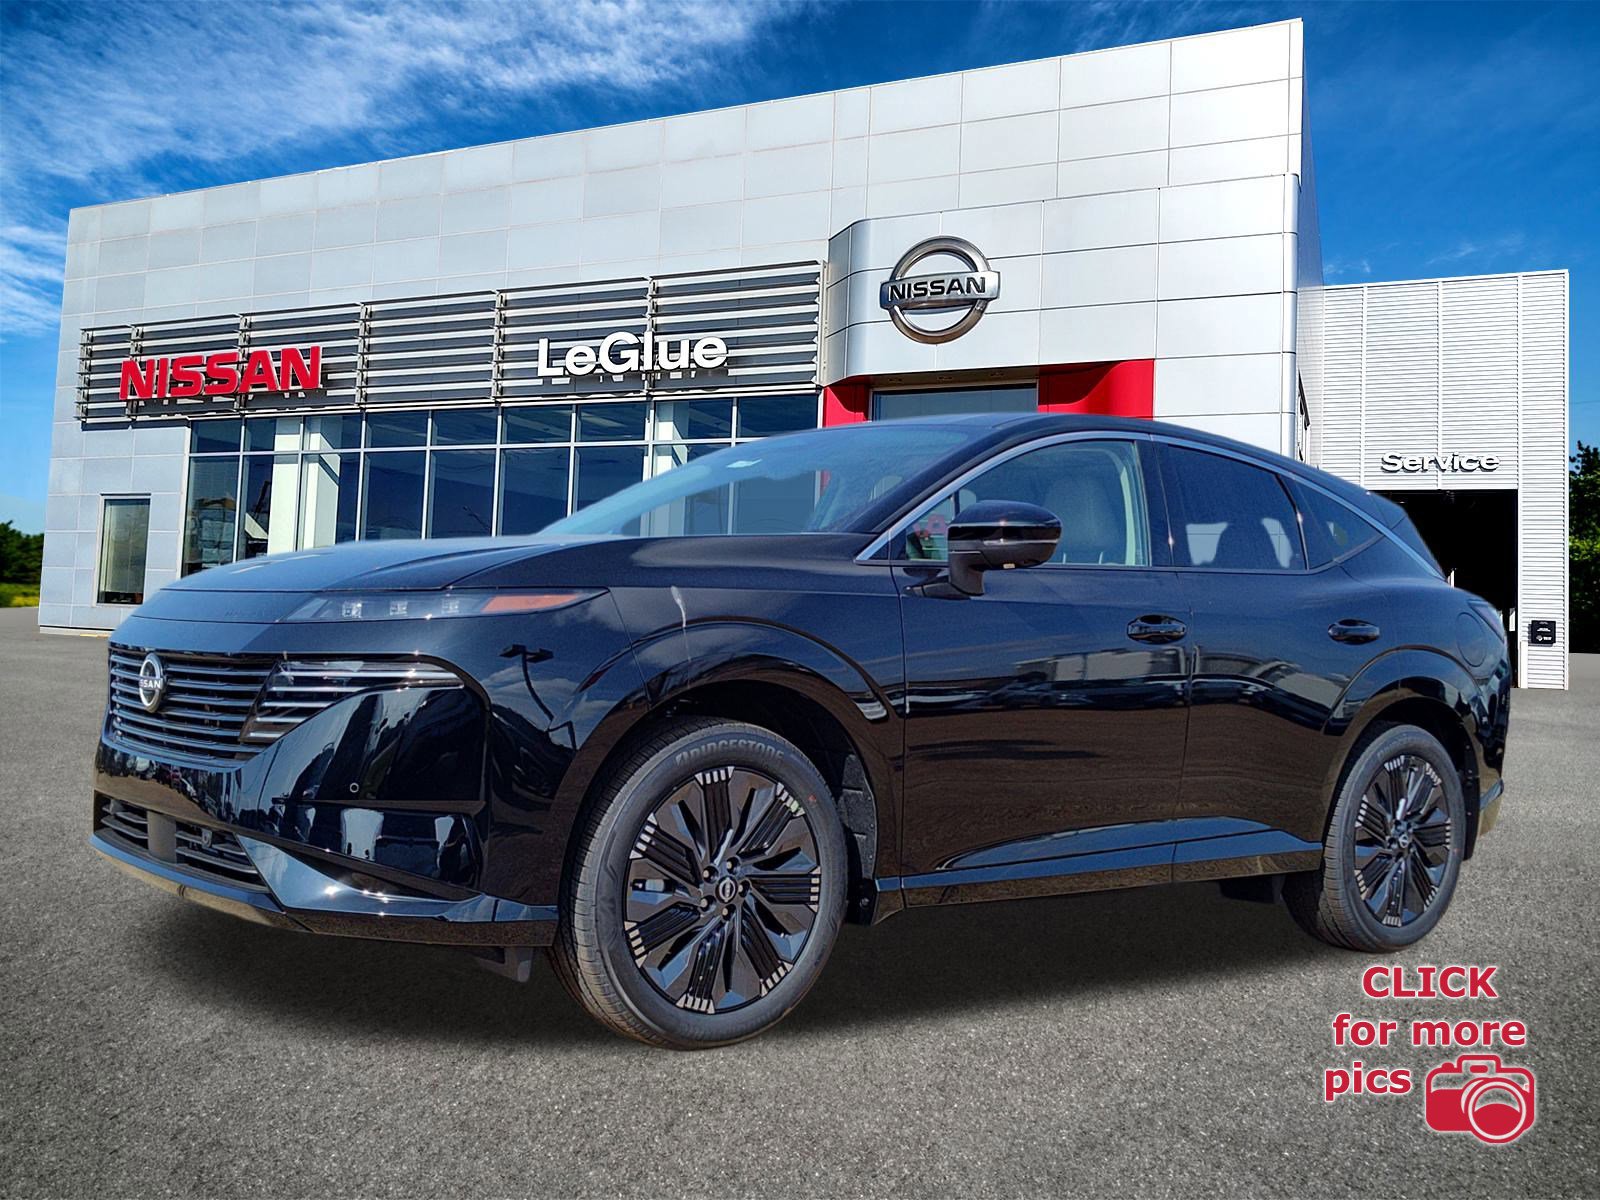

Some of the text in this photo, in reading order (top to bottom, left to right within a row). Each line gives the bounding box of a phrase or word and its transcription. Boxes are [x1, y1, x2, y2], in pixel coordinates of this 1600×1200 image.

[887, 277, 986, 301] NISSAN
[537, 331, 729, 377] LeGlue
[119, 345, 323, 400] NISSAN
[1381, 451, 1500, 473] Service
